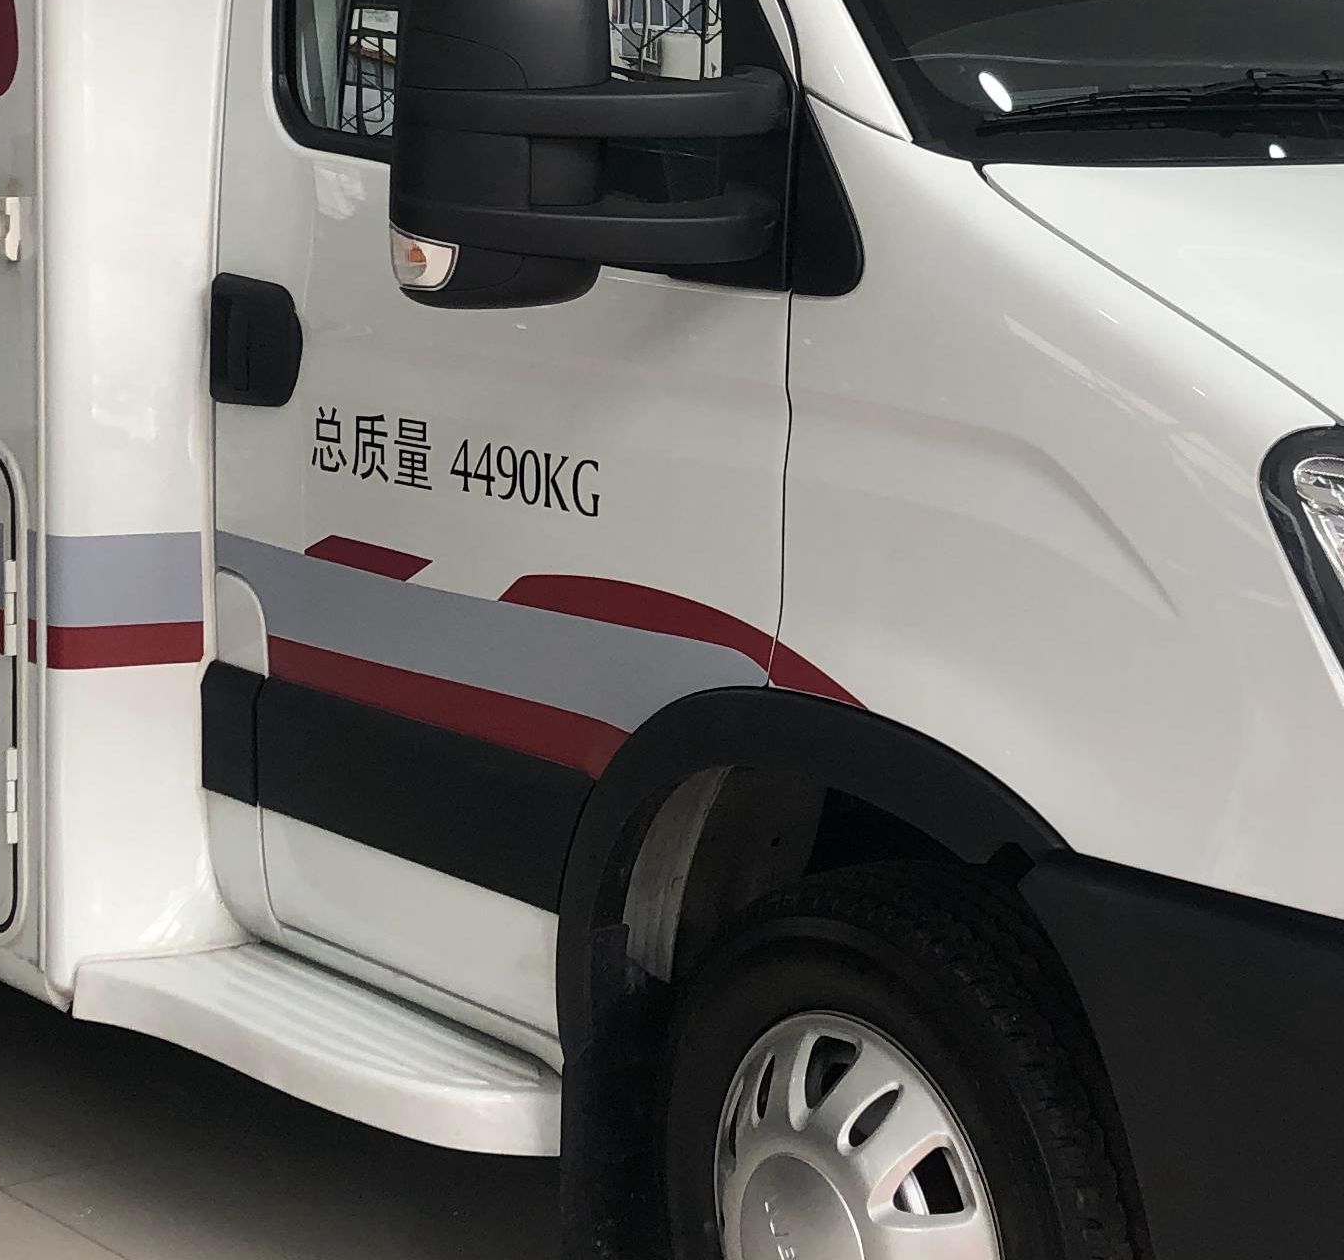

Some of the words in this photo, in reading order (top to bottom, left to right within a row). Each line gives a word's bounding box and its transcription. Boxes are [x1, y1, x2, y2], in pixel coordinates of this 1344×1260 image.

[311, 406, 433, 491] 总质量
[449, 438, 601, 518] 4490KG
